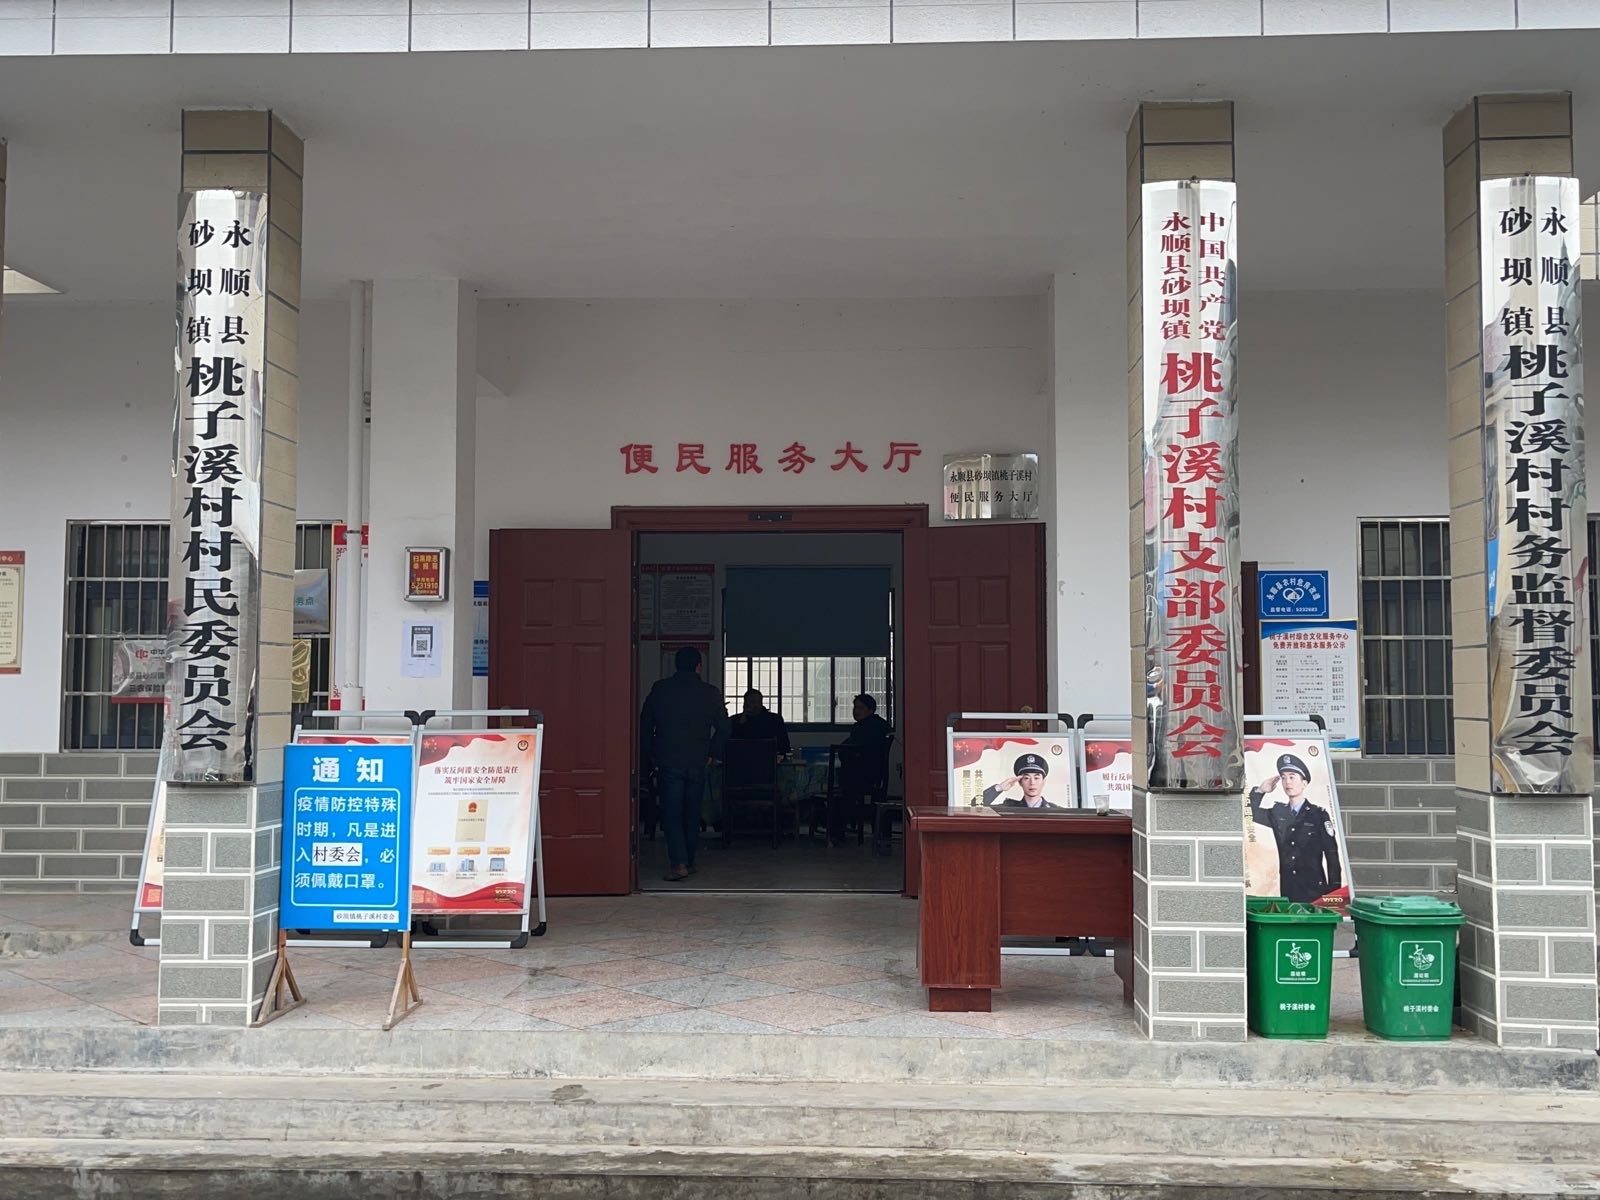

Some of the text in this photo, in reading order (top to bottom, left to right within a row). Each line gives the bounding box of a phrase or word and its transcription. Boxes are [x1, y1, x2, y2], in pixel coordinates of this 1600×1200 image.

[186, 219, 214, 345] 砂坝镇
[218, 220, 252, 345] 永顺县
[1160, 211, 1192, 340] 永顺县砂坝镇
[1198, 211, 1226, 341] 中国共产党
[1499, 206, 1534, 337] 砂坝镇
[1540, 206, 1569, 337] 永顺县
[620, 441, 922, 475] 便民服务大厅
[950, 470, 1032, 482] 永顺县砂坝镇桃子溪村
[950, 491, 1032, 503] 便民服务大厅
[176, 357, 245, 750] 桃子溪村村民委员会
[1161, 352, 1229, 759] 桃子溪村支部委员会
[1502, 345, 1579, 756] 桃子溪村村务监督委员会
[297, 796, 397, 813] 疫情防控特殊
[312, 757, 384, 783] 通知
[294, 873, 384, 889] 须佩戴口罩。
